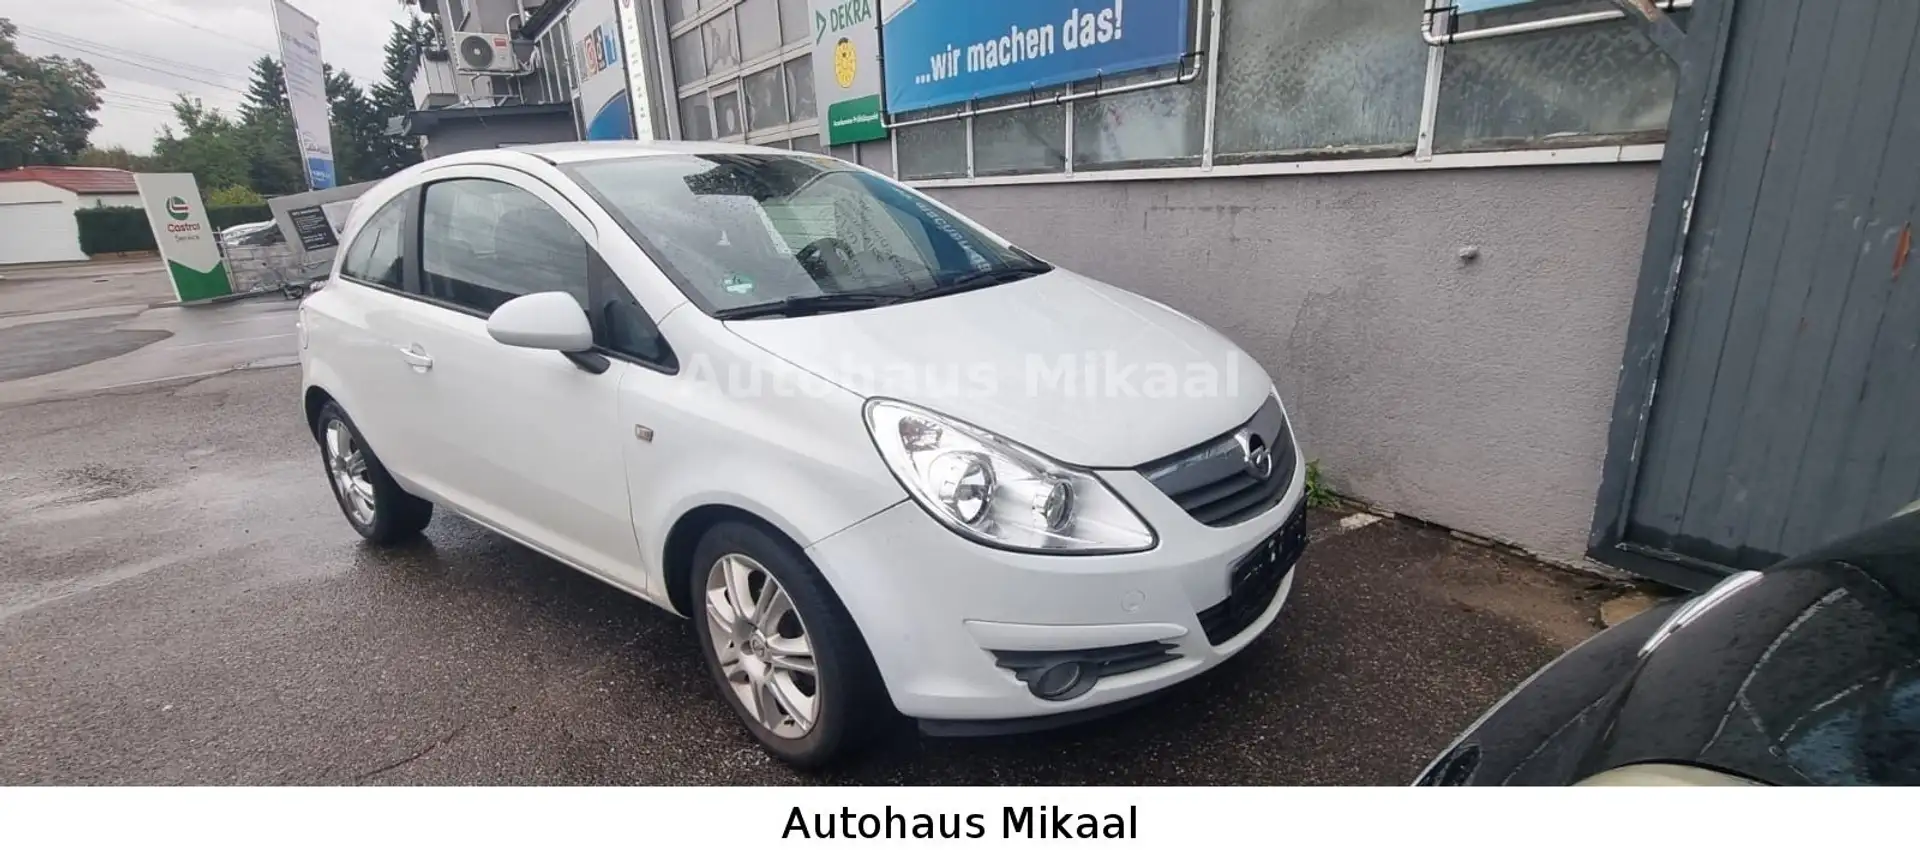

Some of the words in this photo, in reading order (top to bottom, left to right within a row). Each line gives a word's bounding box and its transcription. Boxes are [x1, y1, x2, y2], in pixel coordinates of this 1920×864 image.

[830, 0, 872, 32] DEKRA
[915, 44, 961, 84] ...wir
[967, 24, 1054, 73] machen
[1063, 0, 1123, 51] das!
